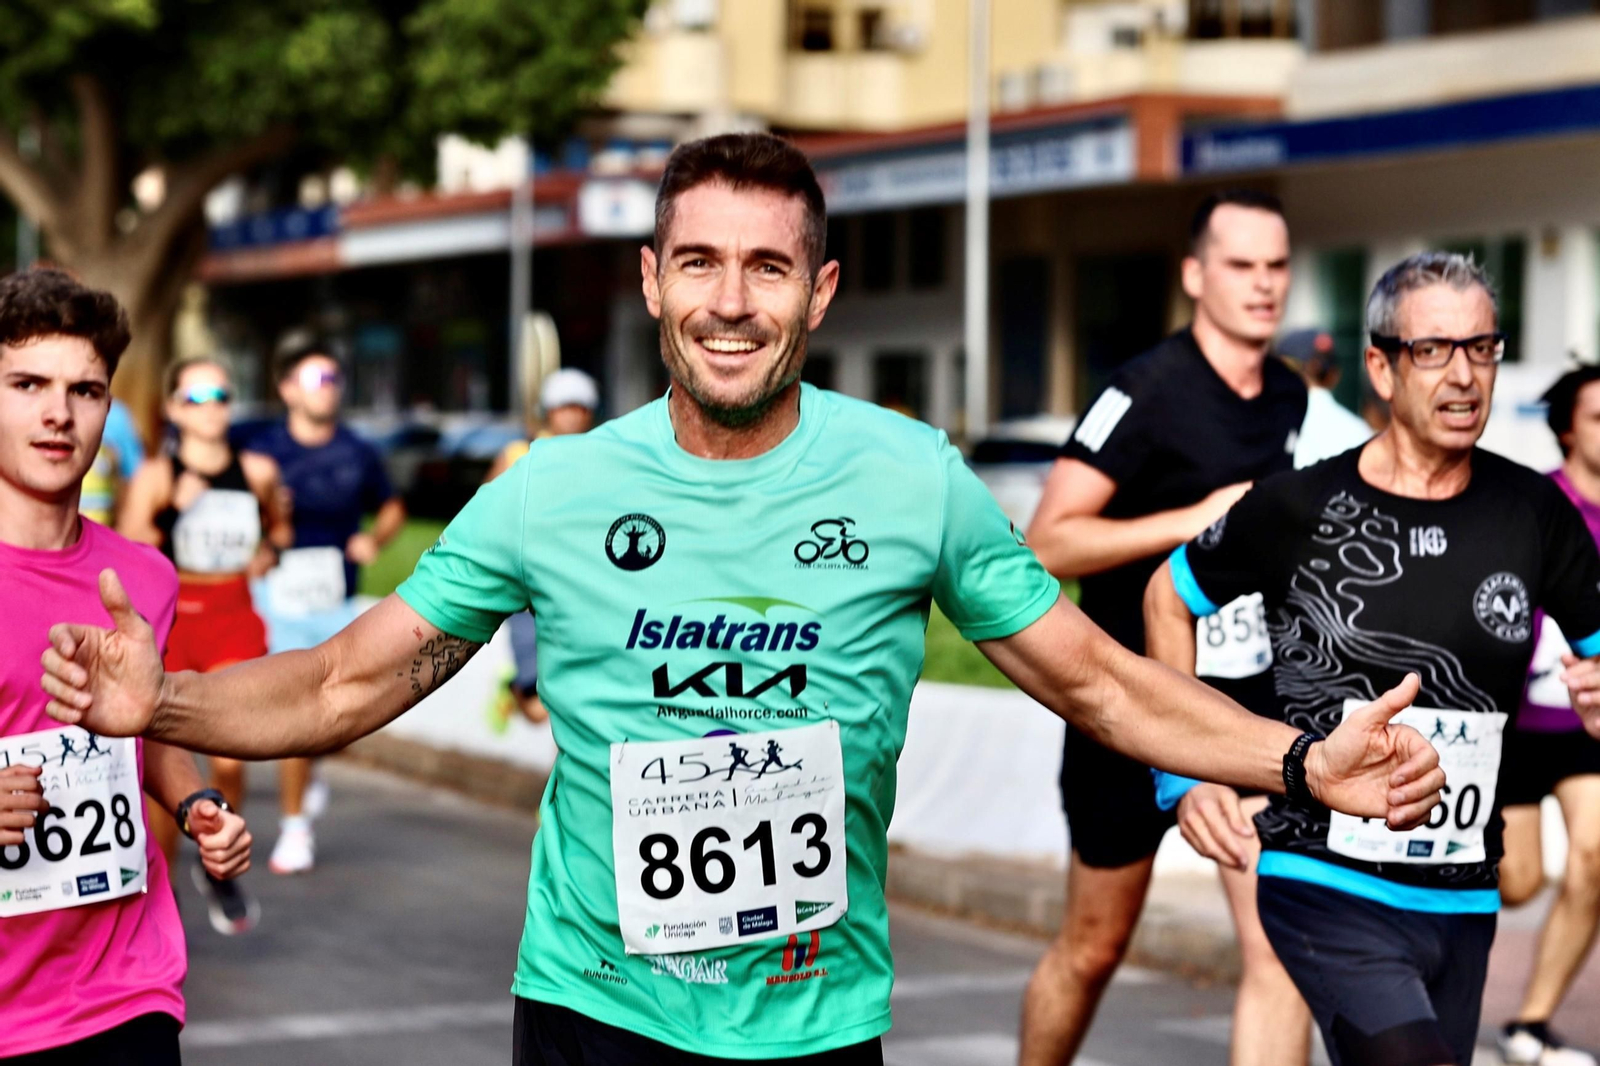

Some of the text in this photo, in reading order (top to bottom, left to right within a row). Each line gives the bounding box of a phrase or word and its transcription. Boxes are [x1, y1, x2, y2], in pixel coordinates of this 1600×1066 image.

[625, 608, 822, 652] Islatrans
[652, 661, 807, 699] KIA
[641, 753, 711, 784] 45
[628, 789, 726, 806] CARRERA
[628, 799, 727, 818] URBANA
[638, 812, 832, 900] 8613
[663, 919, 707, 931] Fundación
[664, 929, 696, 940] Unicaja
